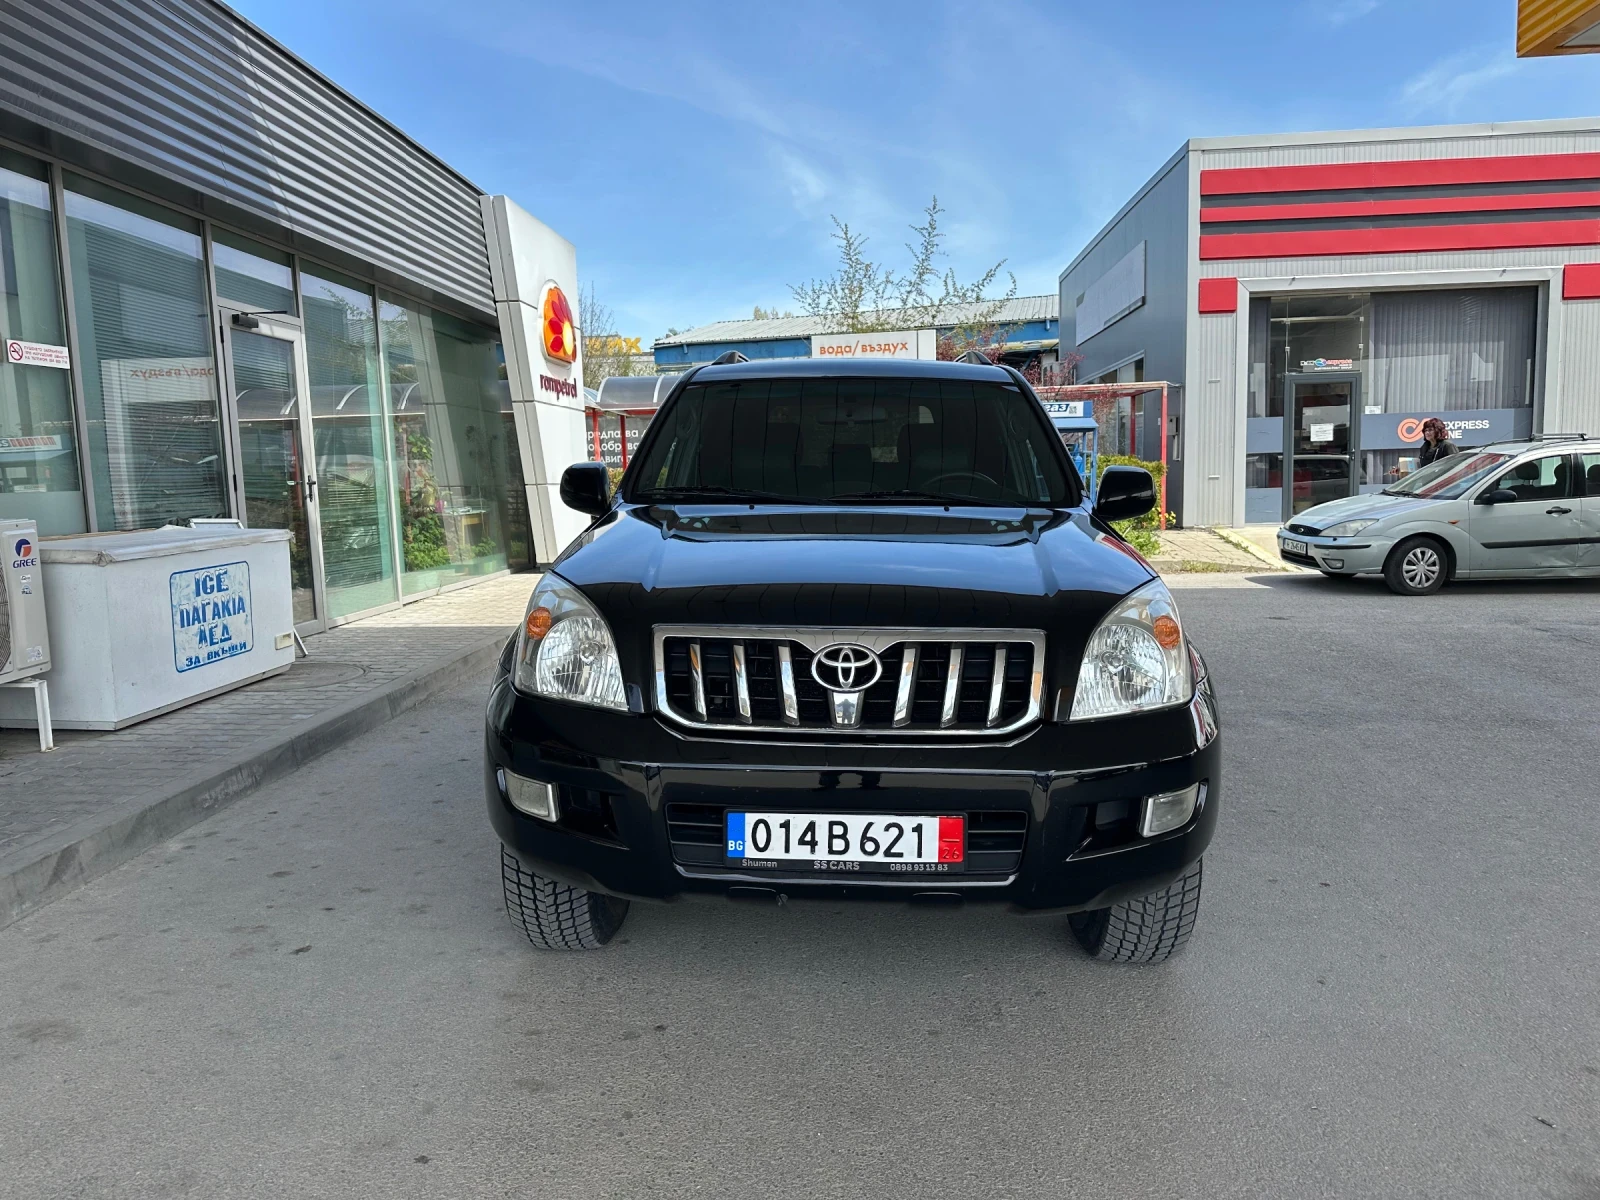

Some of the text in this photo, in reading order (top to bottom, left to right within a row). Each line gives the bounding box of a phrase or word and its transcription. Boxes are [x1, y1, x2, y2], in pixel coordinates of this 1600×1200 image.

[819, 340, 908, 356] вода/въздух
[540, 374, 577, 400] rompetrol
[13, 558, 37, 568] GREE
[194, 568, 229, 597] ICE
[185, 655, 201, 667] ЗА
[728, 840, 744, 851] BG
[942, 847, 960, 859] 26
[742, 859, 778, 868] Shumen
[813, 860, 860, 870] SS CARS
